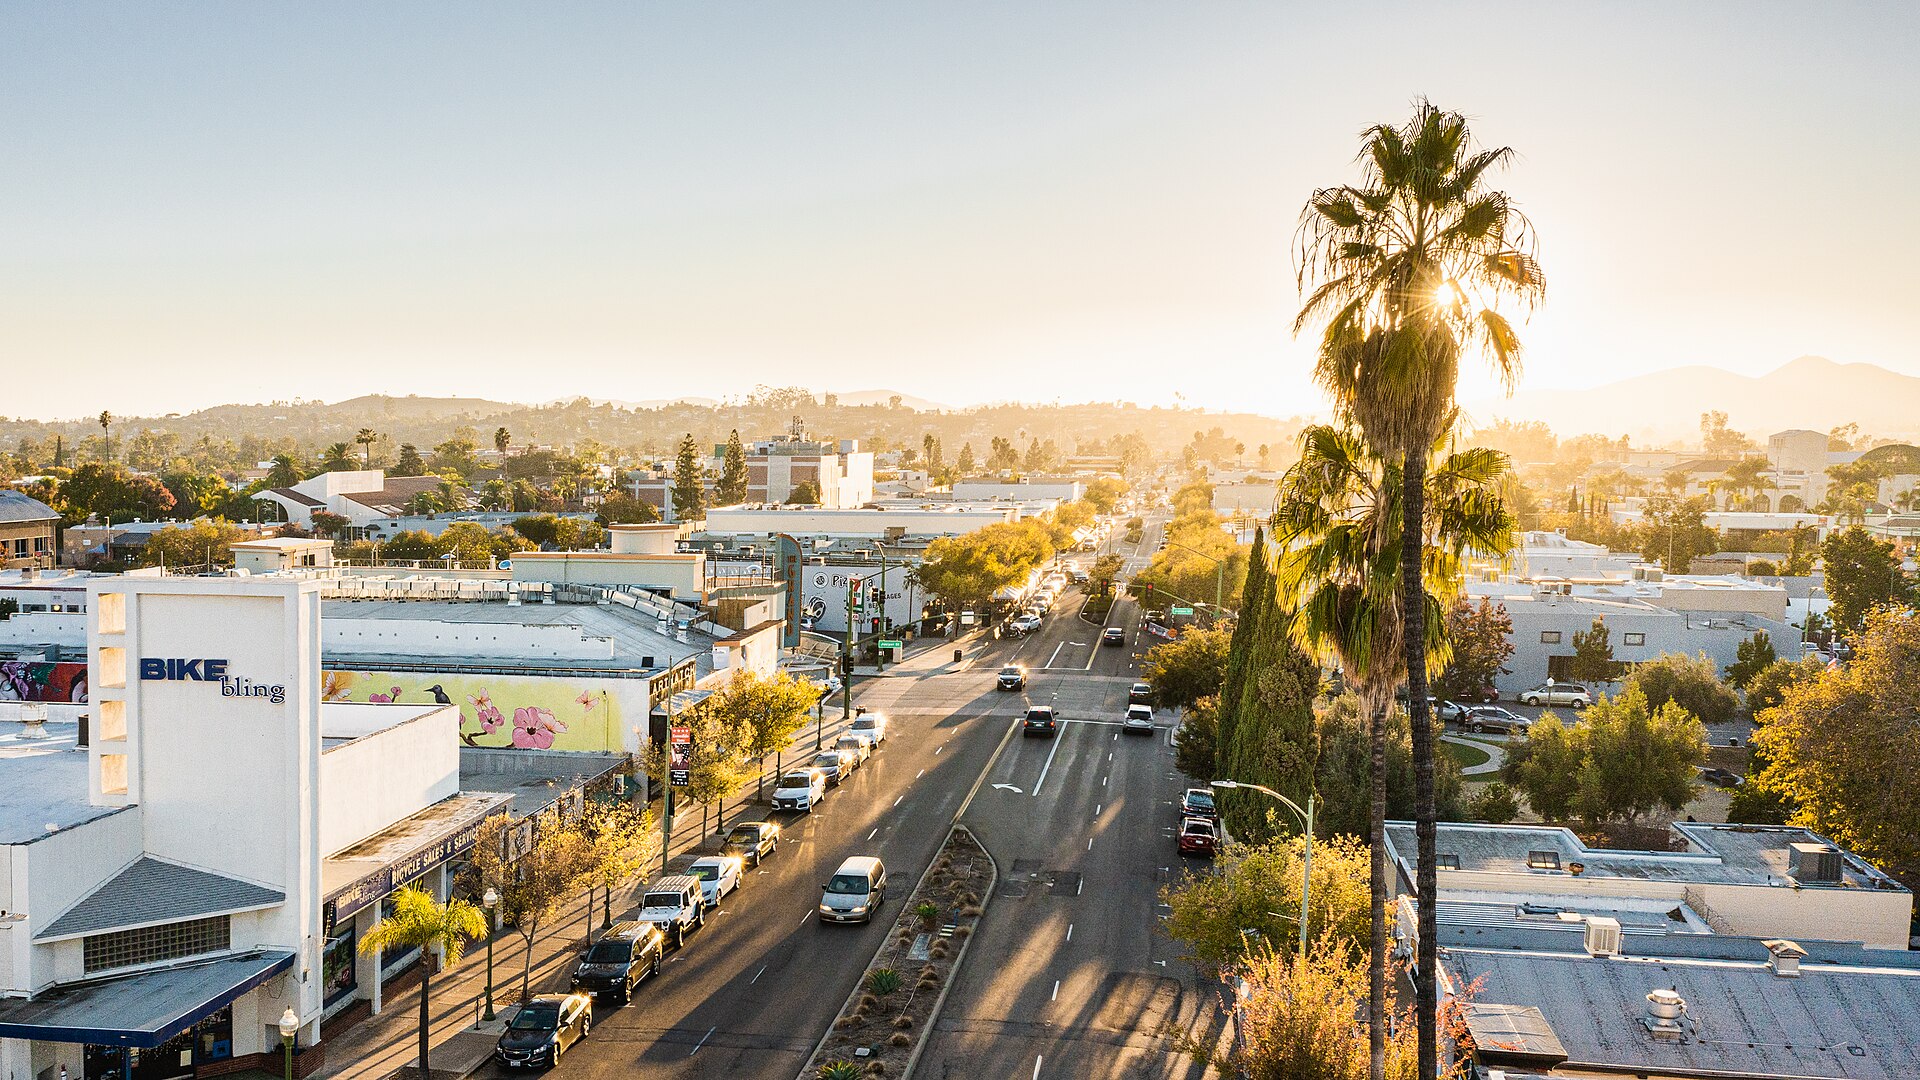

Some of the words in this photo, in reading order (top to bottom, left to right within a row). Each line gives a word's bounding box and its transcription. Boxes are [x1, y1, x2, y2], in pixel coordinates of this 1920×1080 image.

[787, 565, 796, 637] GRAND
[139, 658, 230, 682] BIKE
[219, 675, 286, 704] bling
[391, 857, 421, 885] BICYCLE
[423, 845, 445, 867] SALES
[446, 841, 452, 854] &
[338, 886, 362, 909] BIKE
